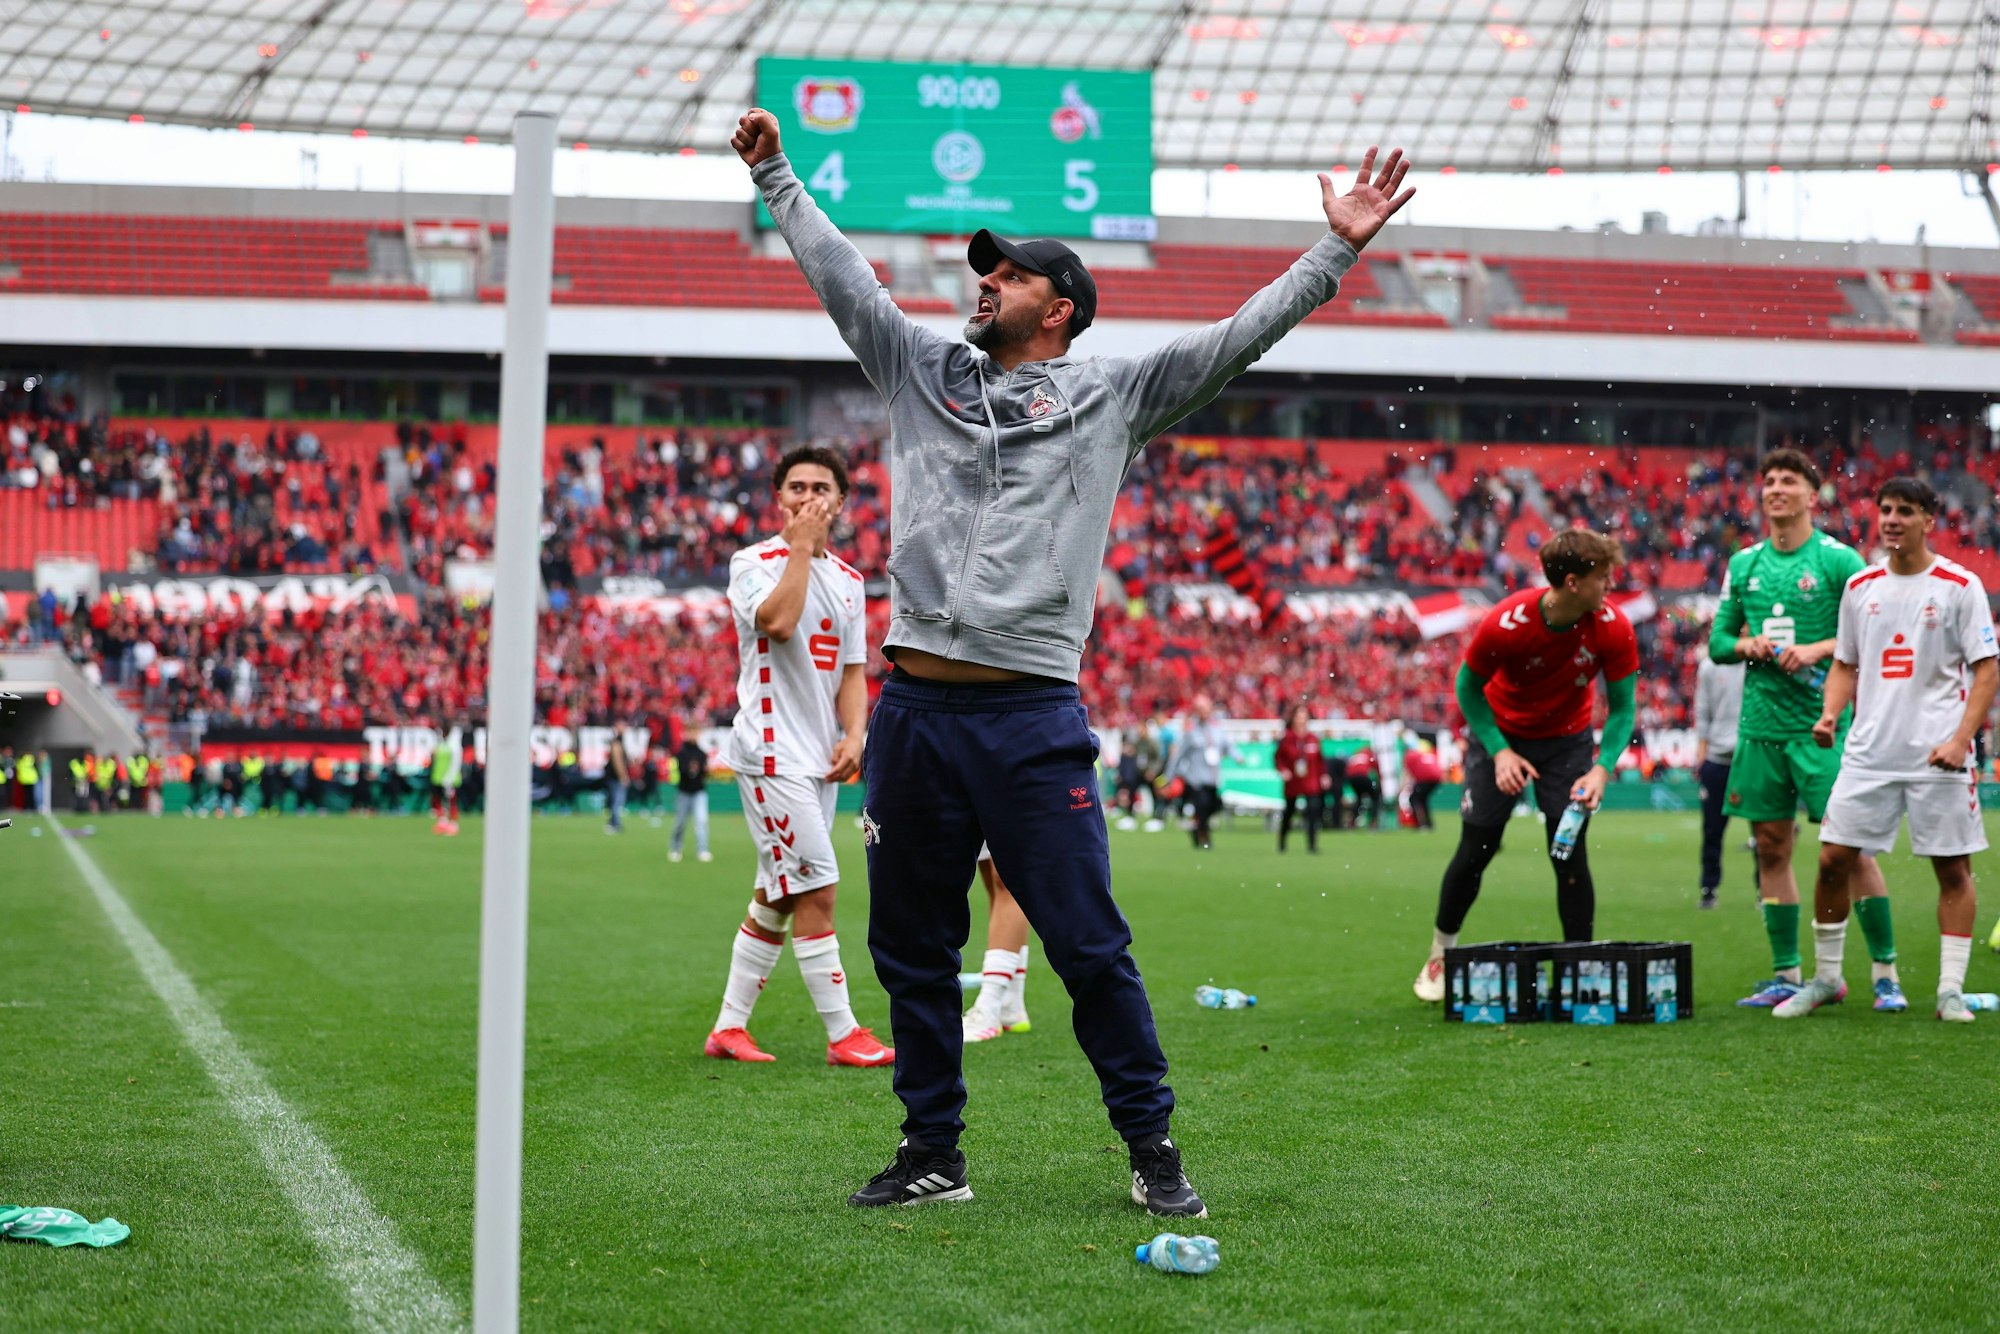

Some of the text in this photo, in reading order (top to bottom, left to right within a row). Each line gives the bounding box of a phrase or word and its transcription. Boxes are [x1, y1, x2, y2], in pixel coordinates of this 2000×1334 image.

[917, 74, 1001, 109] 90:00
[809, 150, 849, 203] 4
[1062, 159, 1099, 212] 5
